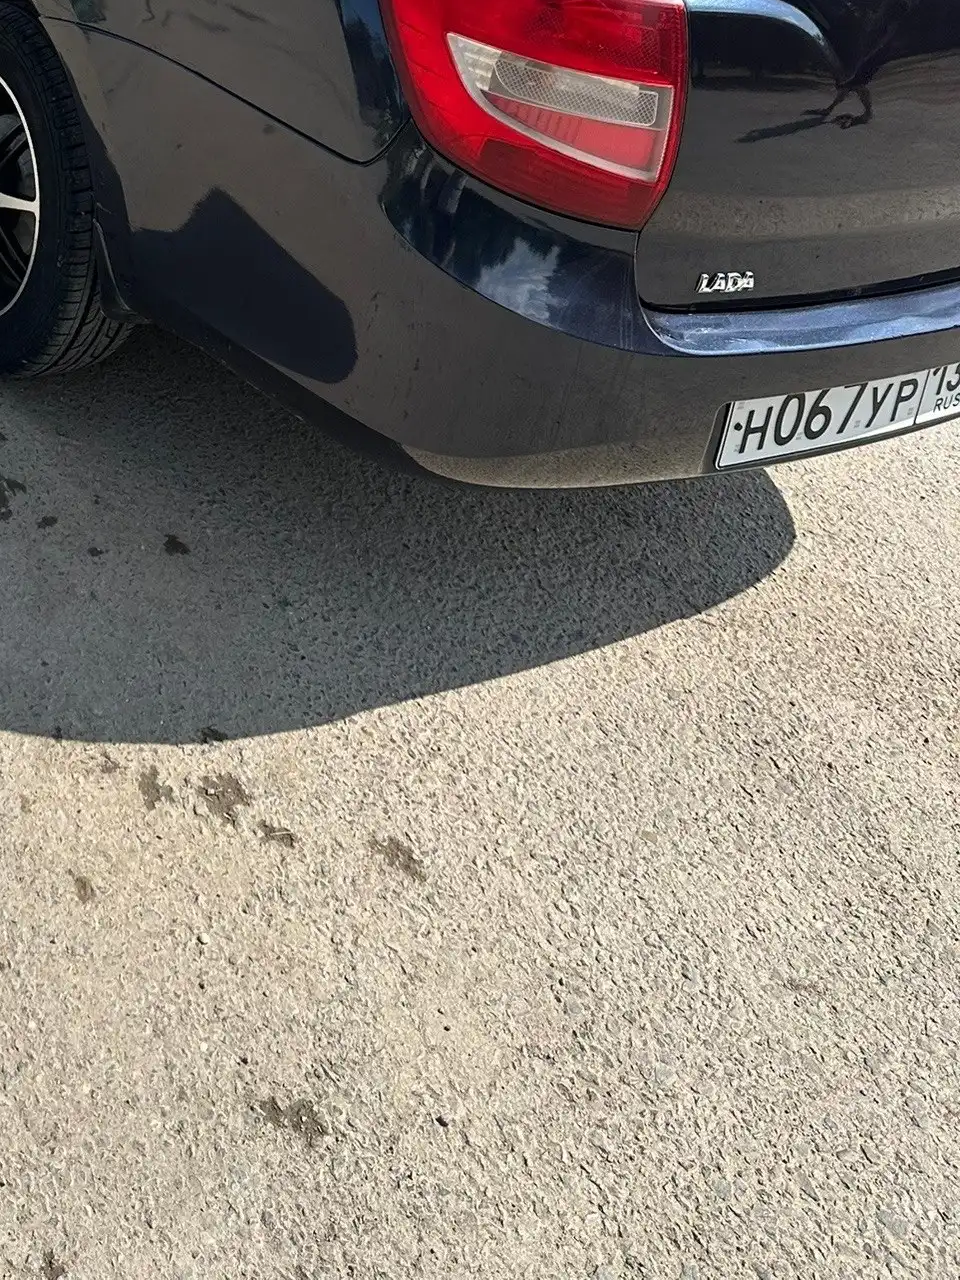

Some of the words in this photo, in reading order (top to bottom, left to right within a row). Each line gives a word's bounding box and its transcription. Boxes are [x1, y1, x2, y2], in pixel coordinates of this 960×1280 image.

[695, 271, 754, 293] LADA
[933, 393, 960, 412] RUS
[739, 378, 919, 454] Н067УР
